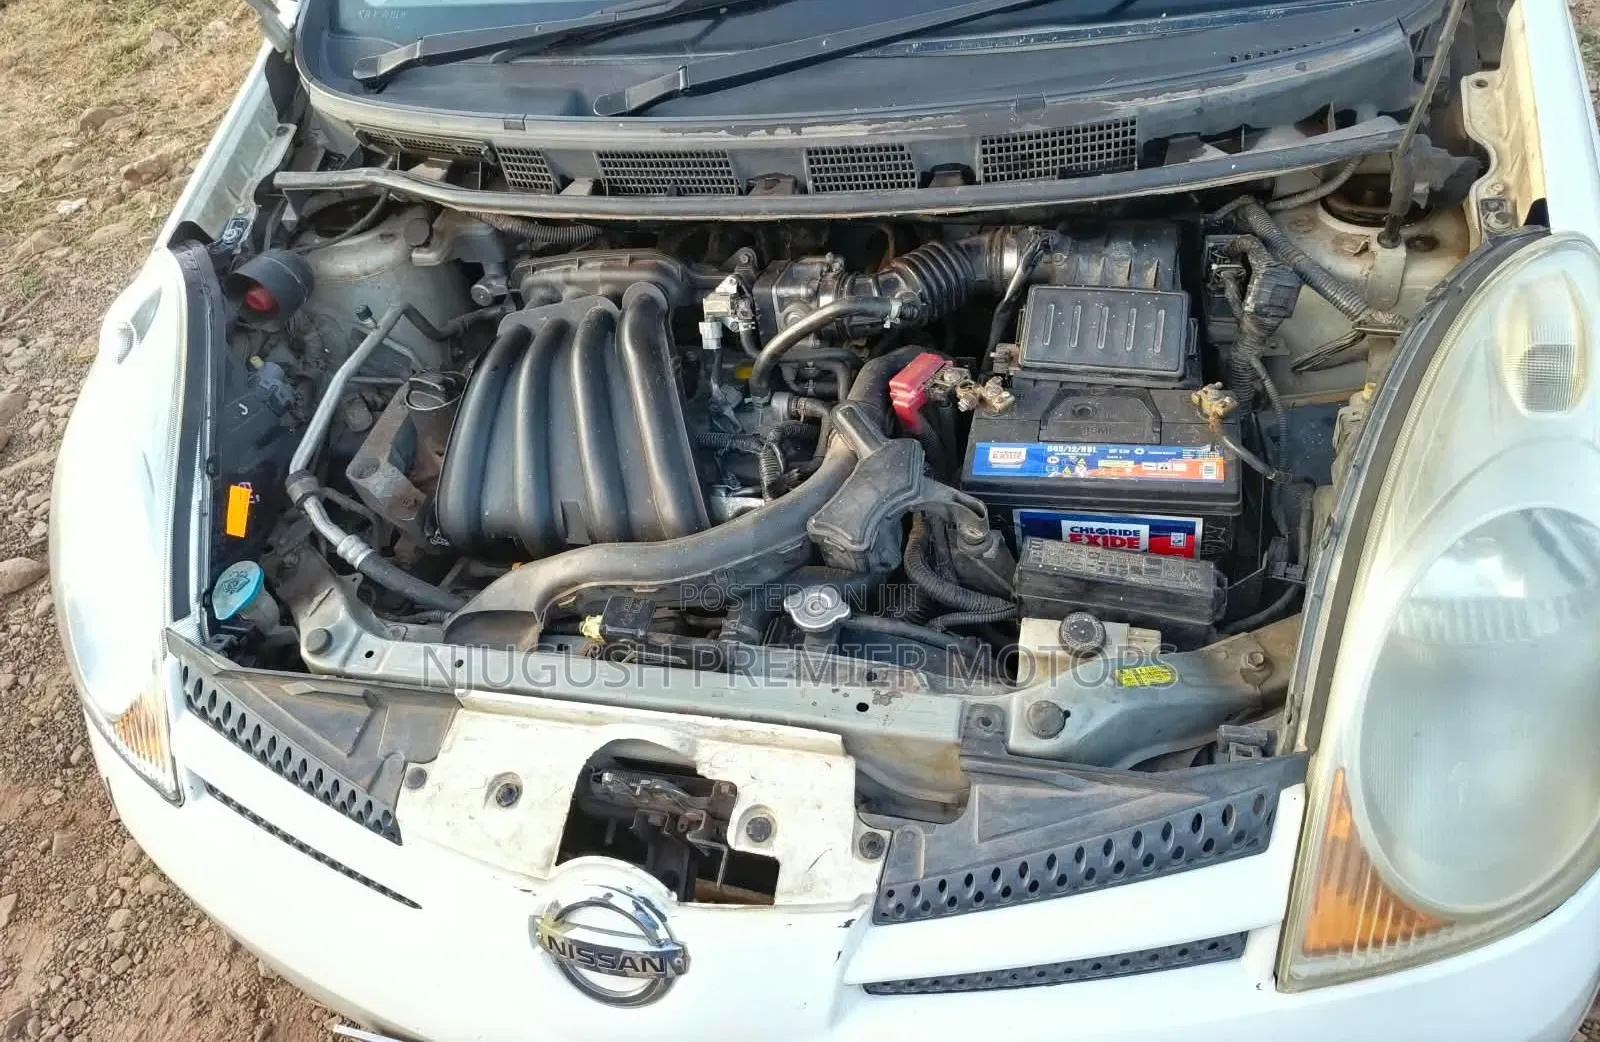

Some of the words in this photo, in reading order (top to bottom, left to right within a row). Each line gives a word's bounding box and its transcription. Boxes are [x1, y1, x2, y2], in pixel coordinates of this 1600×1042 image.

[1069, 526, 1141, 537] CHLORIDE
[1069, 533, 1141, 549] EXIDE
[547, 935, 666, 973] NISSAN
